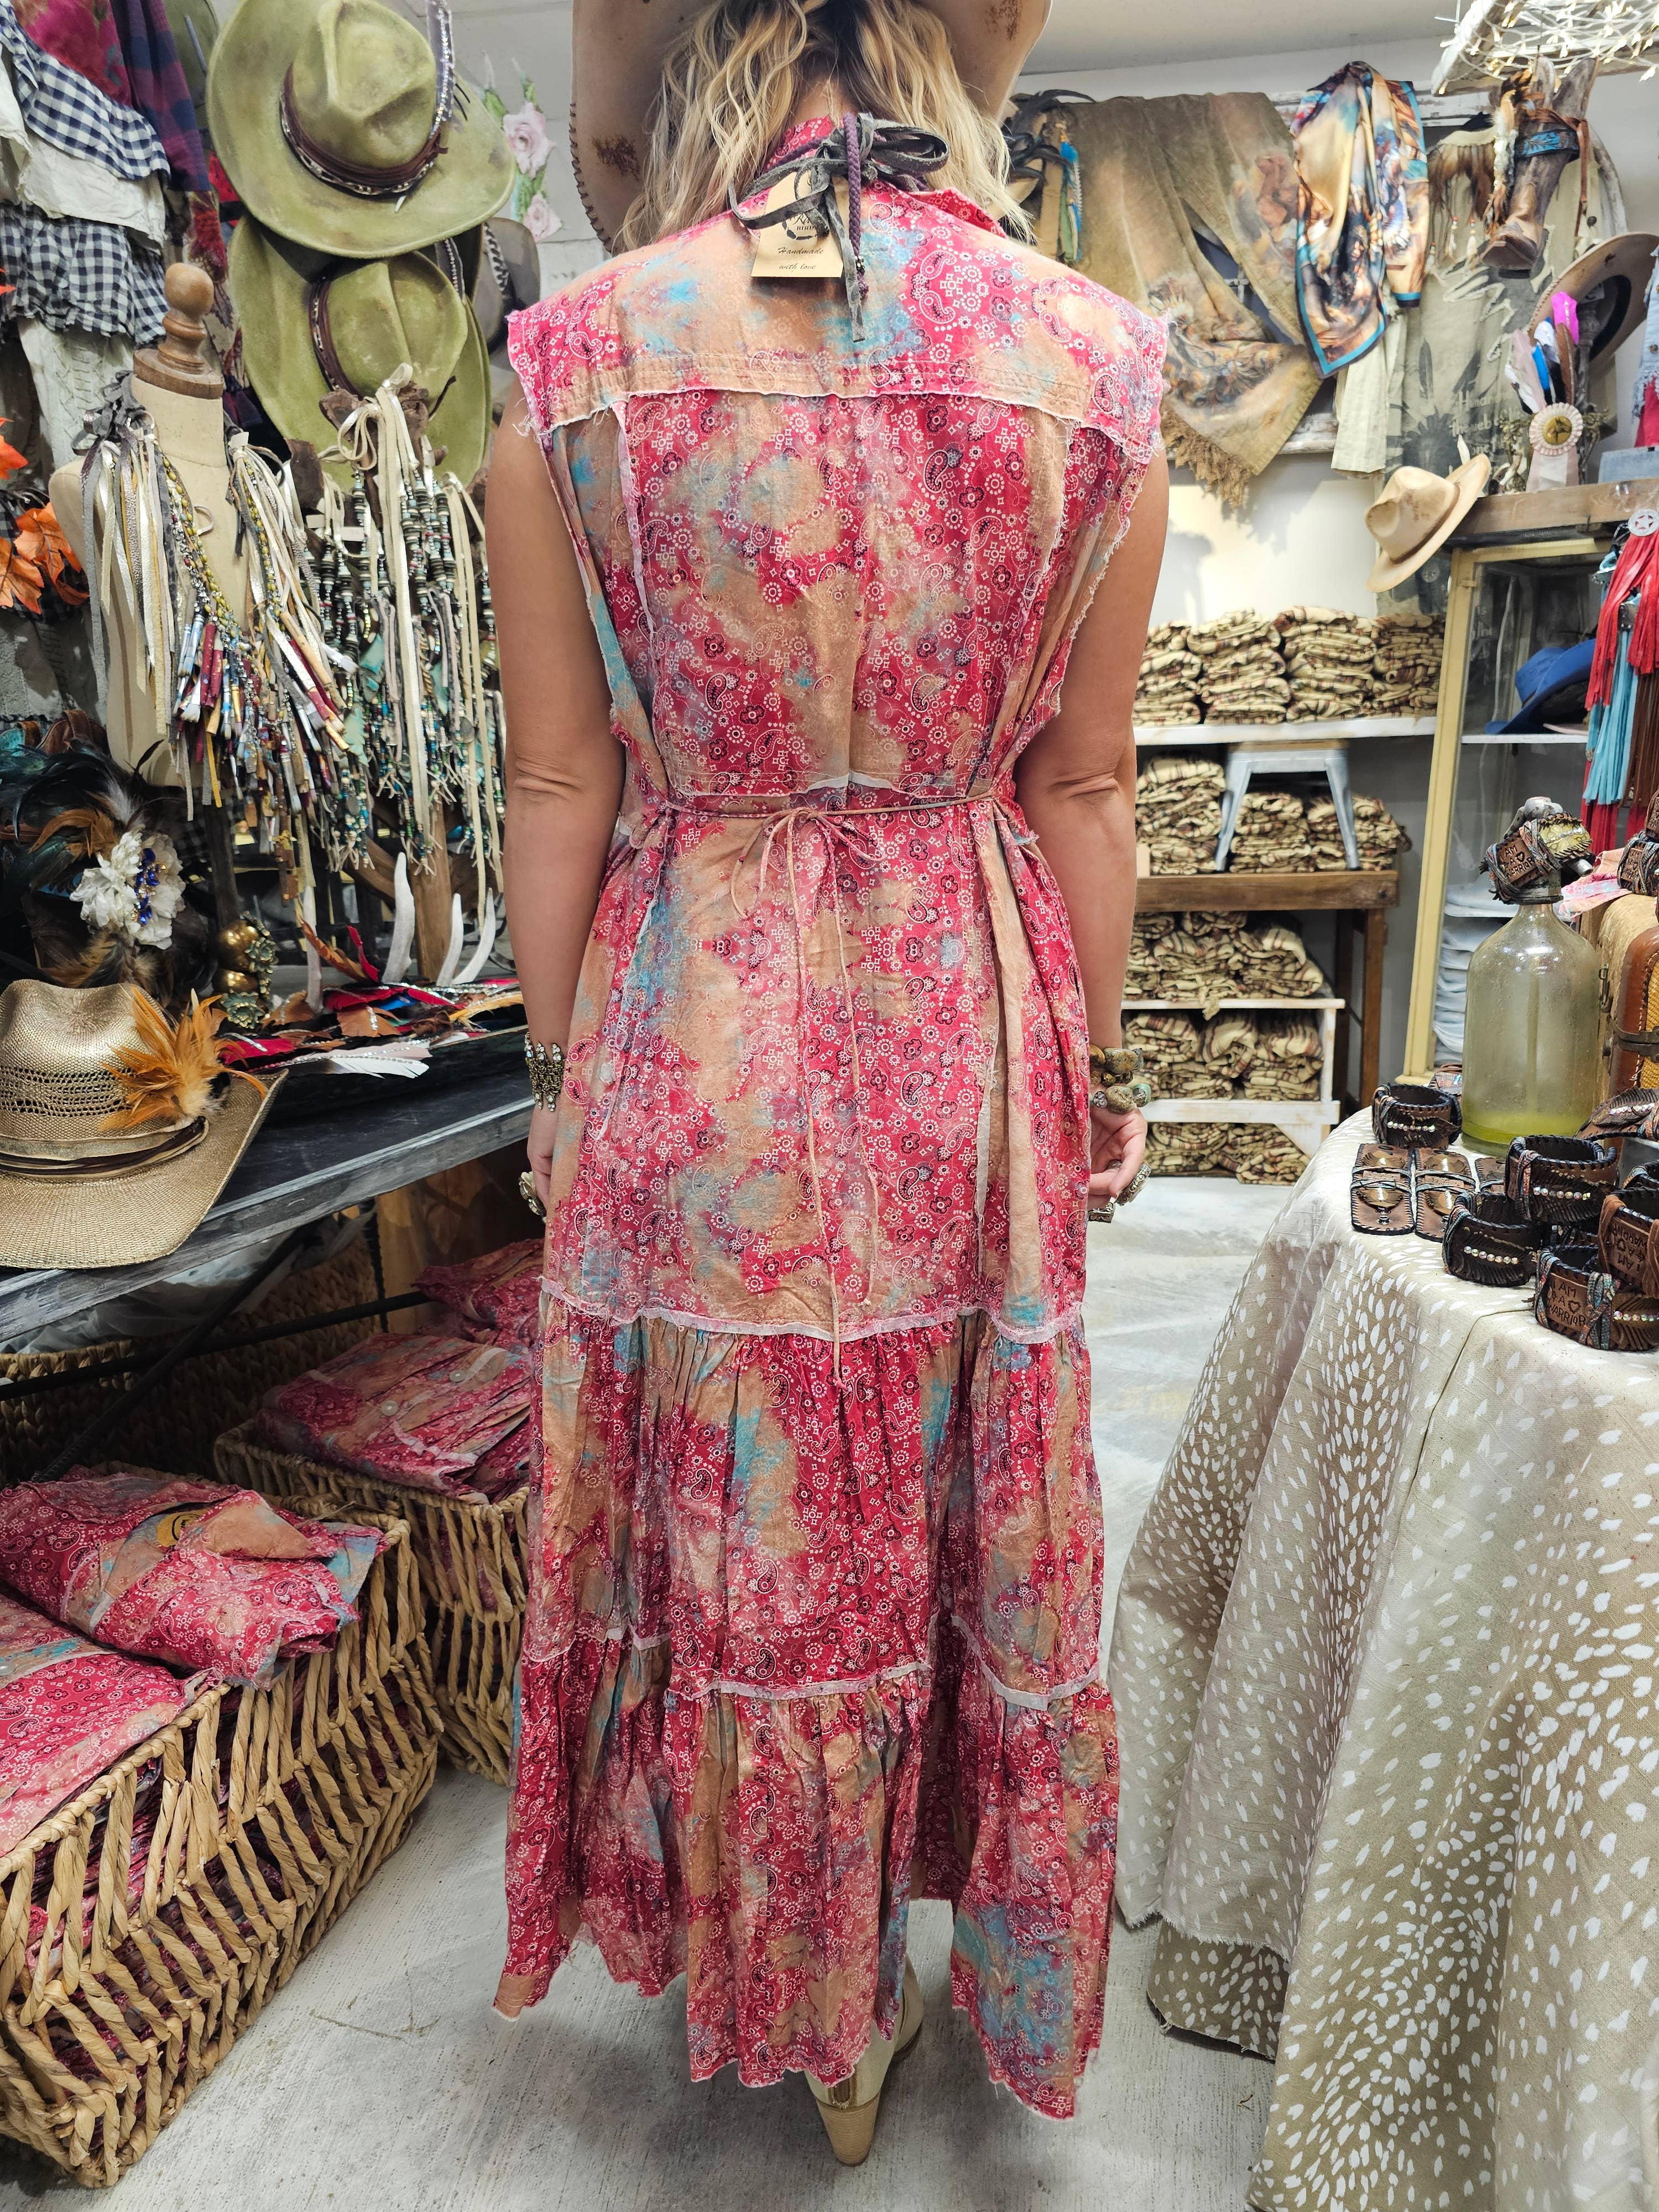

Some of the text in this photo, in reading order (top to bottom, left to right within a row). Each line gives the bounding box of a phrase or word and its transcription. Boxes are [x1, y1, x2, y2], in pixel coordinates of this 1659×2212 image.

[1505, 845, 1518, 858] AM
[1506, 857, 1535, 878] WARRIOR
[1558, 1282, 1577, 1298] AM
[1558, 1295, 1566, 1307] A
[1548, 1304, 1586, 1326] WARRIOR
